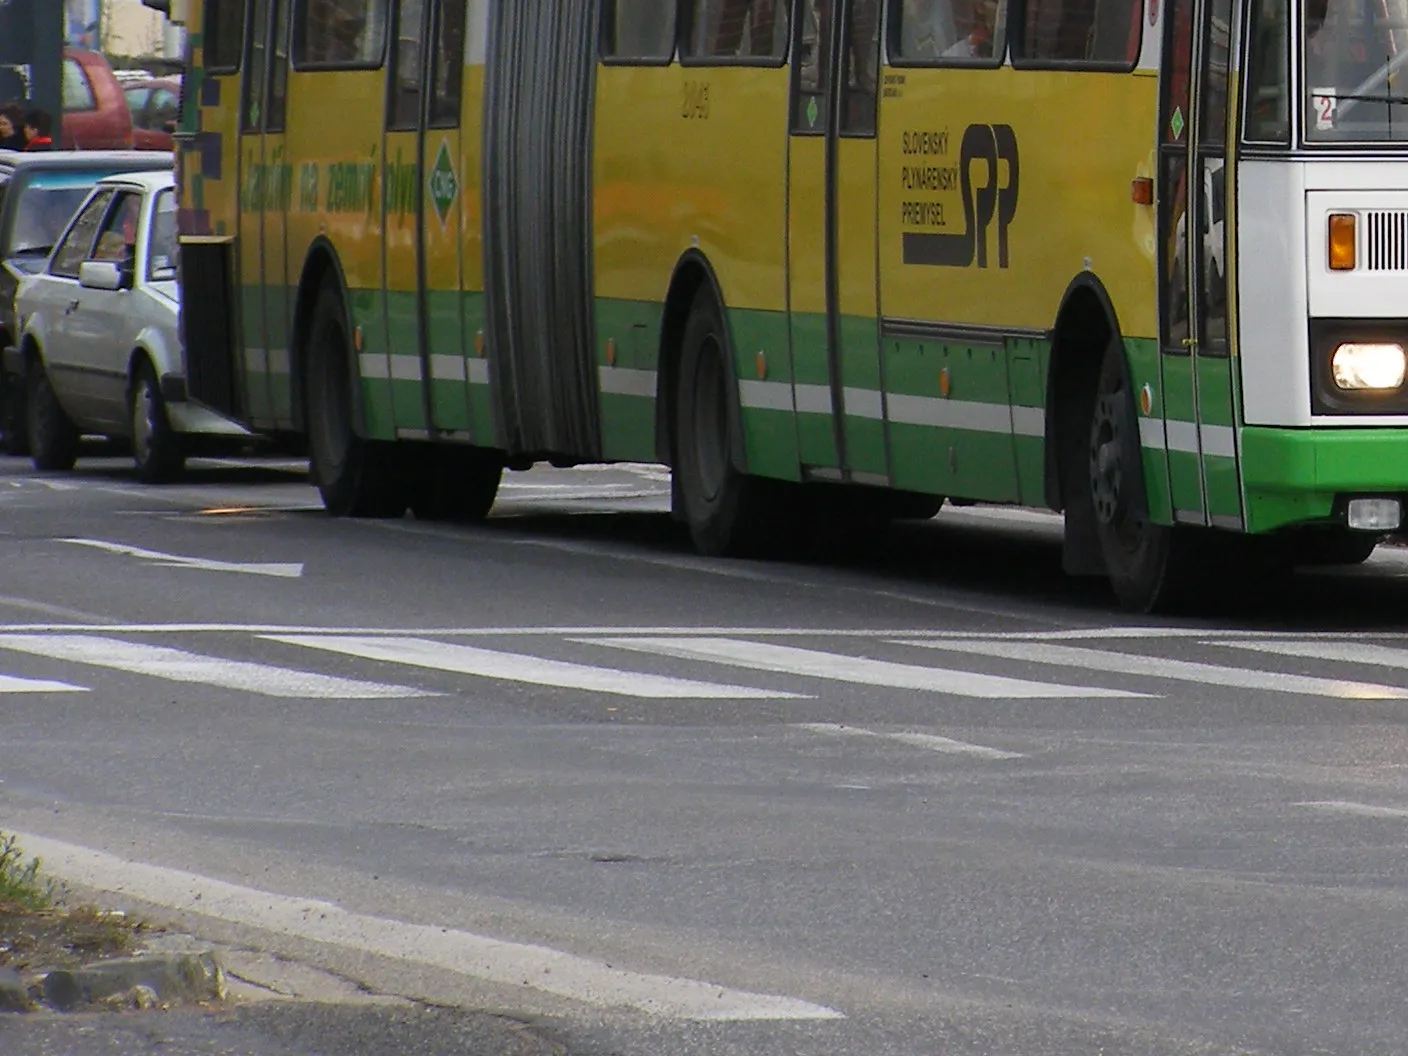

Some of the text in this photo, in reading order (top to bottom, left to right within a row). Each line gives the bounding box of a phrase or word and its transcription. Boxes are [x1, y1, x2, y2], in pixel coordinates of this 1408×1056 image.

[1320, 95, 1333, 121] 2
[902, 126, 950, 155] SLOVENSKÝ
[902, 160, 959, 192] PLYNÁRENSKÝ
[902, 200, 947, 226] PRIEMYSEL
